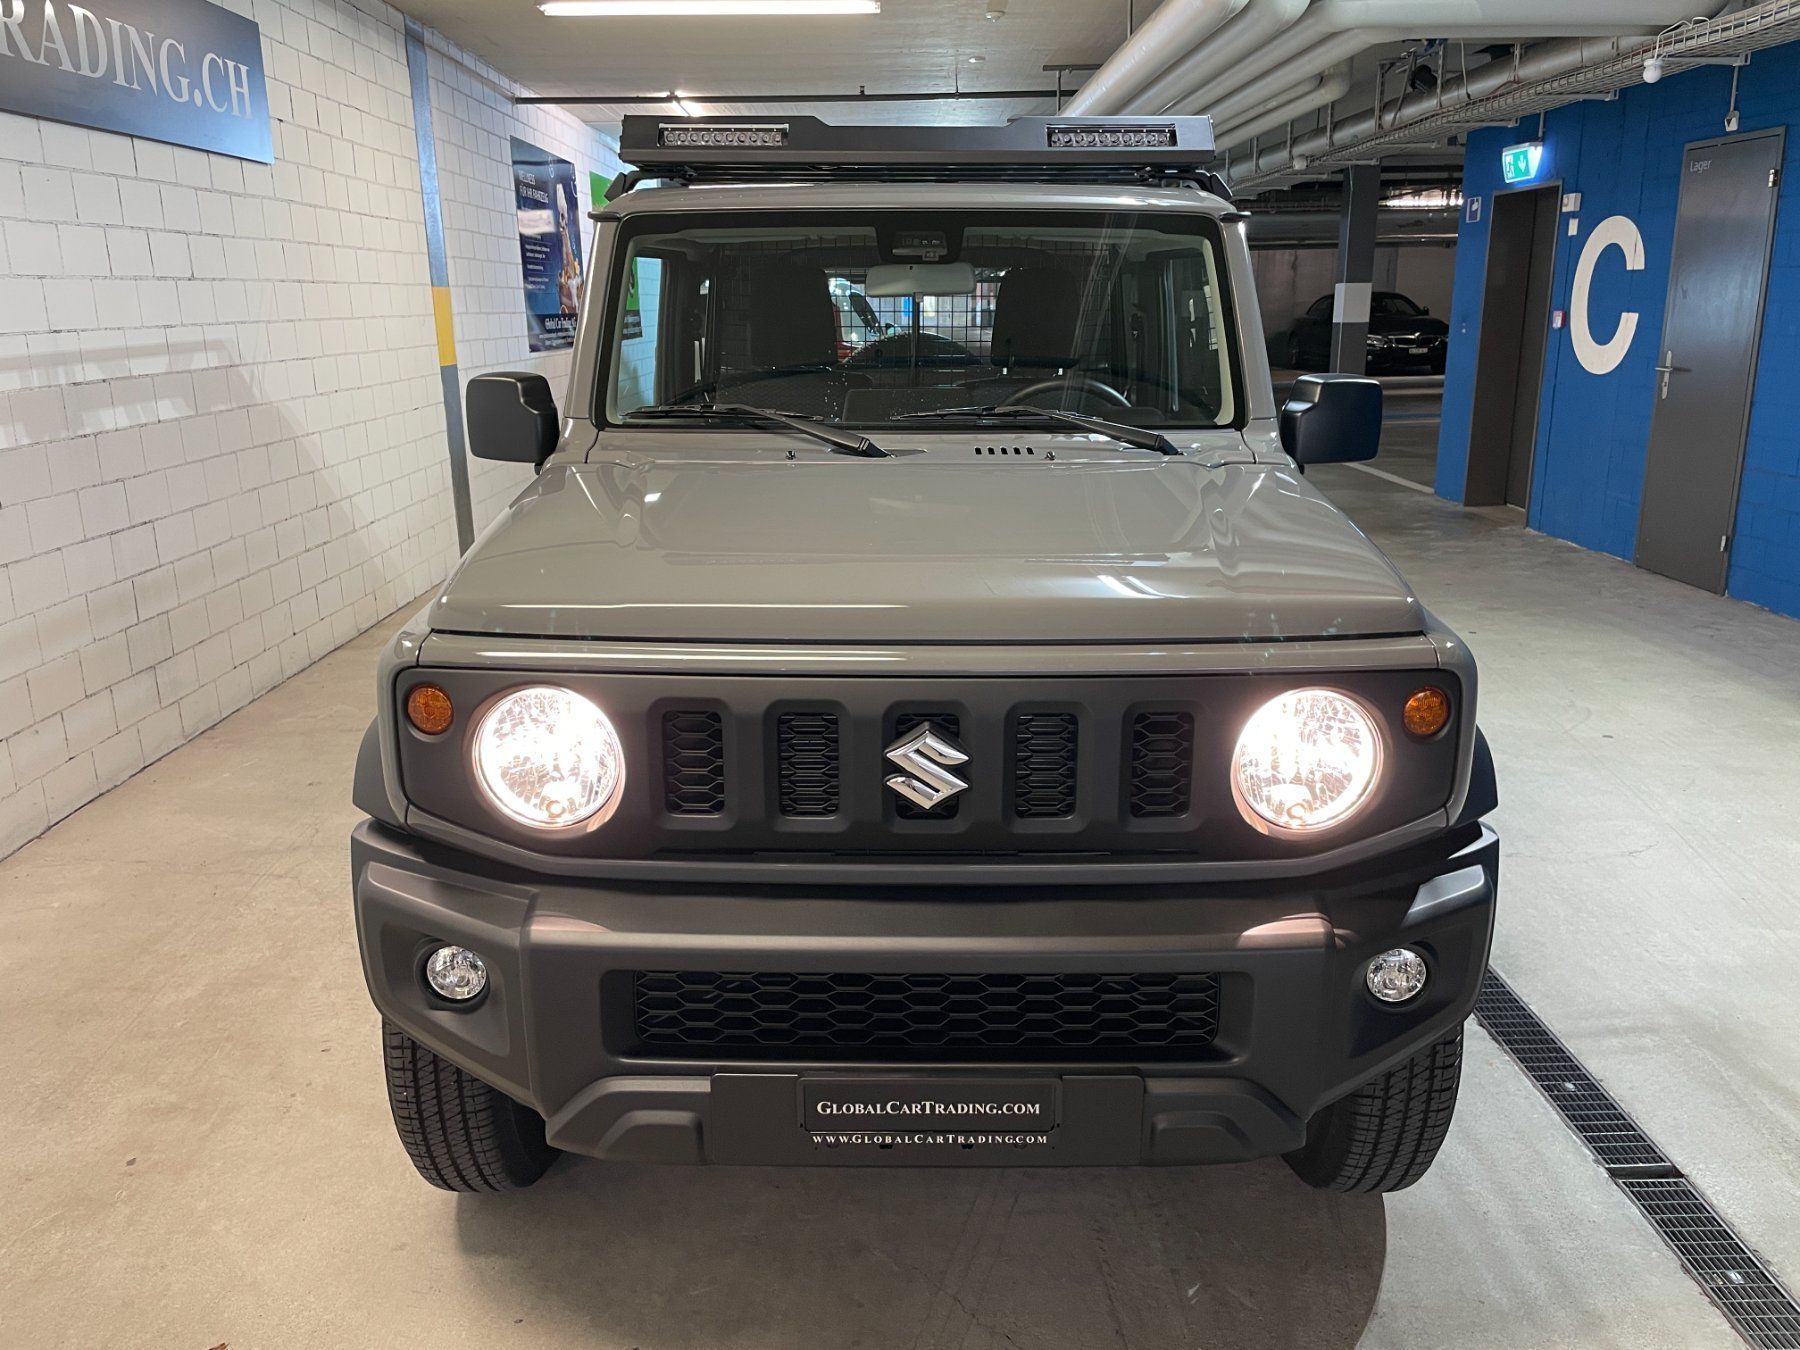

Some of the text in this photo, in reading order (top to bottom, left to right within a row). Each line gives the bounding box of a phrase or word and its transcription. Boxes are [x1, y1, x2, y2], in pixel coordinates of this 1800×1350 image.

[0, 0, 254, 119] RADING.CH
[1690, 160, 1711, 174] Lager
[1570, 215, 1645, 375] C
[816, 1101, 1040, 1115] GLOBALCARTRADING.COM
[812, 1134, 1048, 1144] WWW.GLOBALCARTRADING.COM
